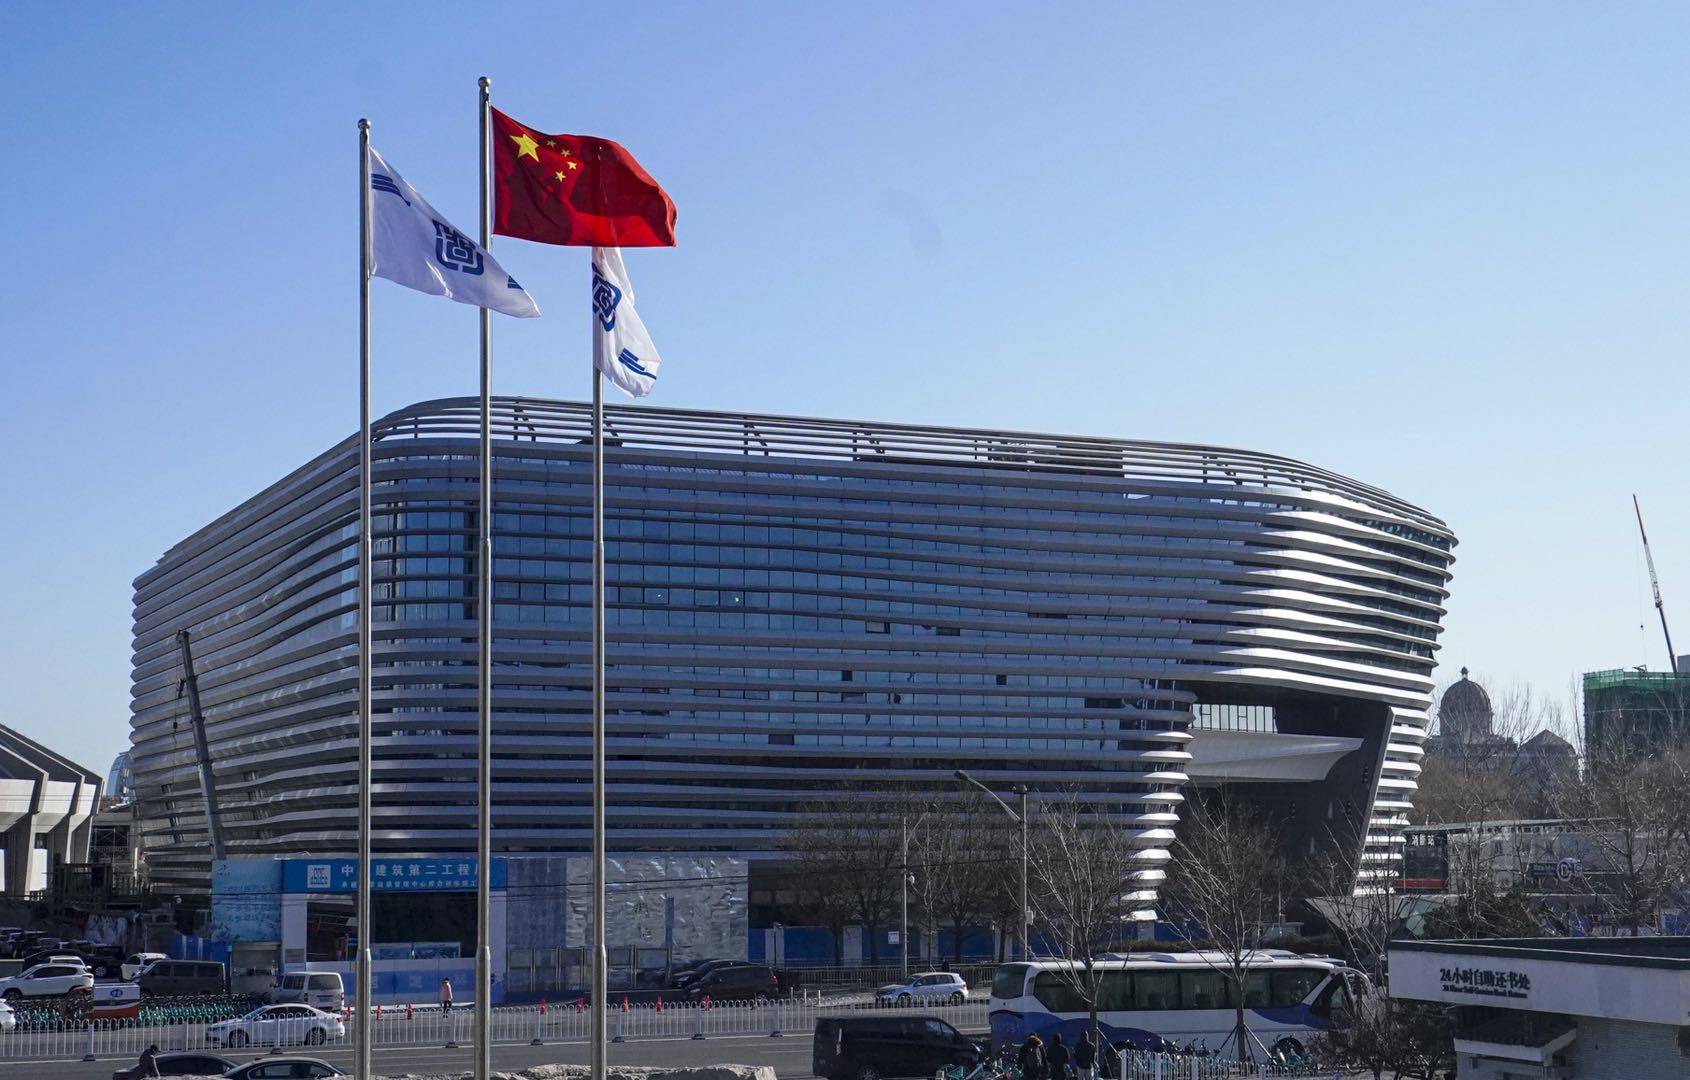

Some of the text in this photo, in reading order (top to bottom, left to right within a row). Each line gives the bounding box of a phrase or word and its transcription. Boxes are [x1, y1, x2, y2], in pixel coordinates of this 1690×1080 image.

[341, 863, 478, 877] 中建筑第二工程
[1440, 967, 1531, 990] 24小时自助还书处
